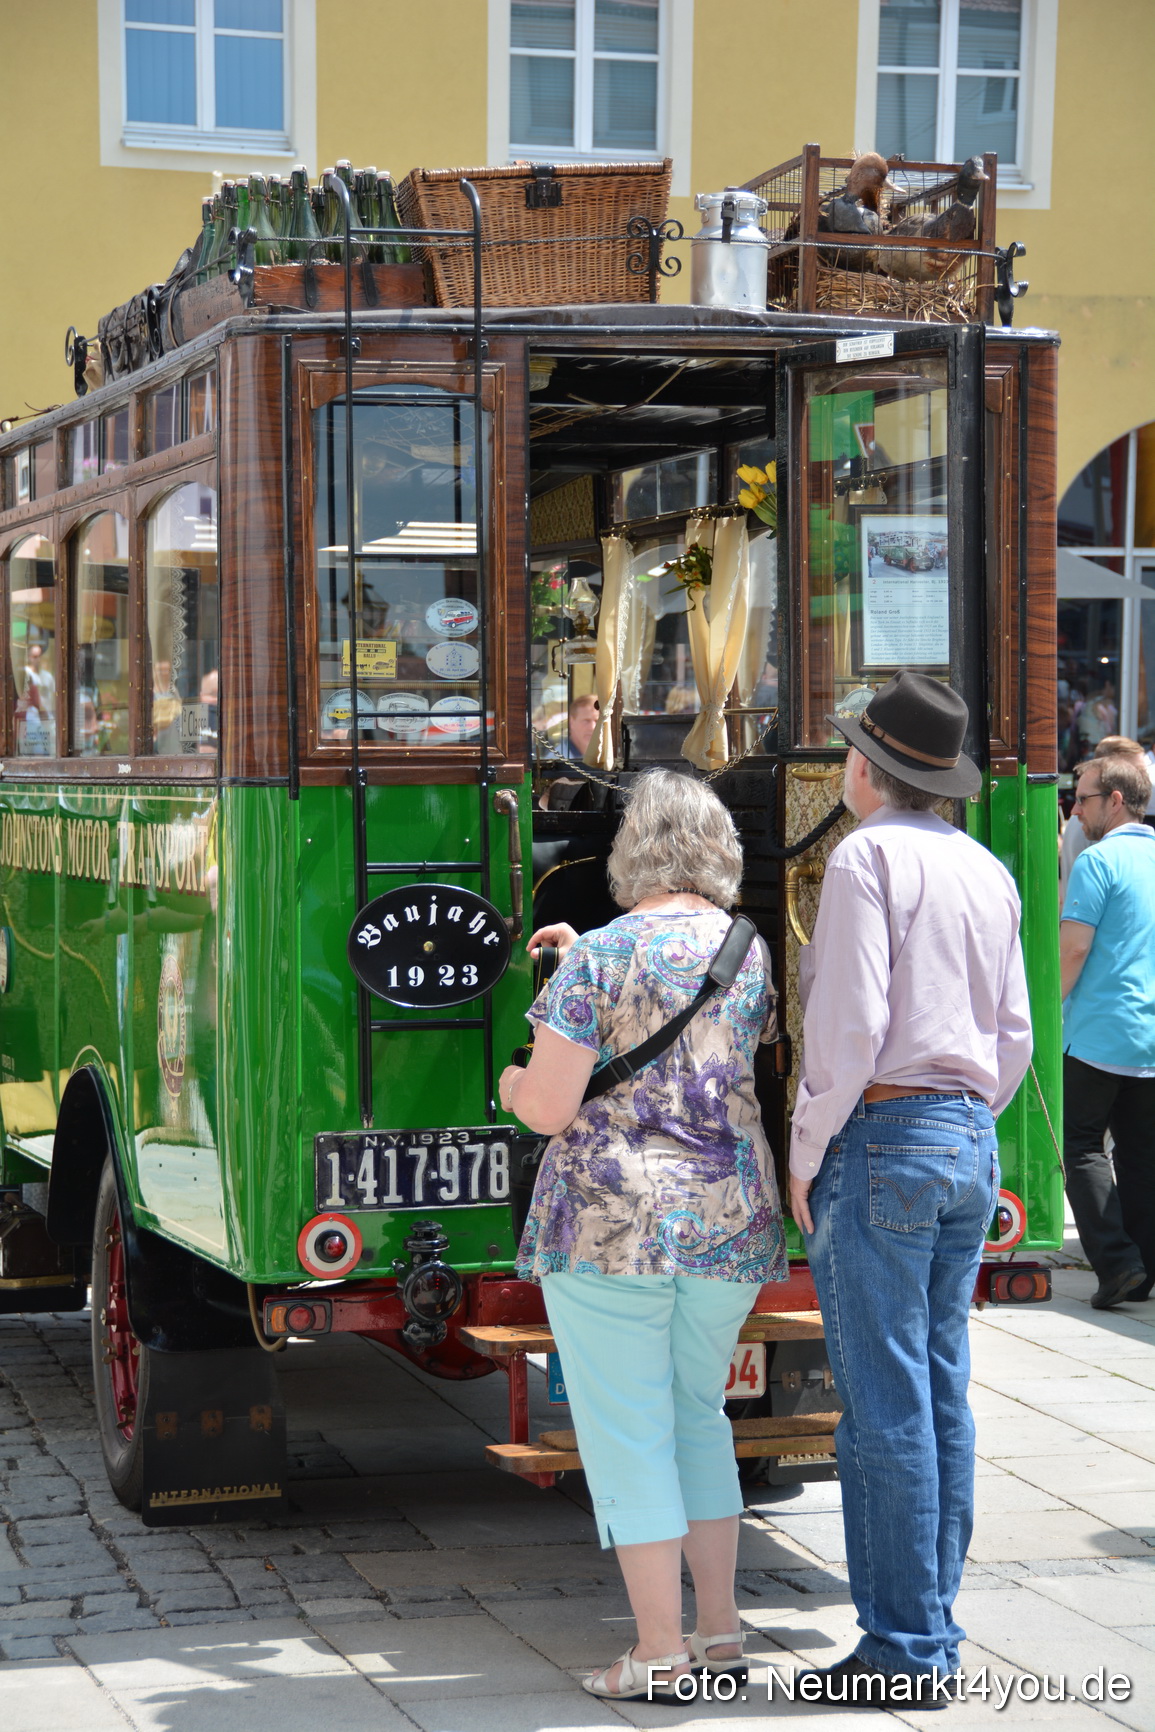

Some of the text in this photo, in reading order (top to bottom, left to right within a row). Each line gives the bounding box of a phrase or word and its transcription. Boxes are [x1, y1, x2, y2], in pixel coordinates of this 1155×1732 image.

[67, 818, 110, 881] MOTOR
[117, 821, 208, 893] TRANSPORT
[357, 895, 500, 950] Baujahr
[412, 1132, 470, 1145] 1923
[152, 1483, 280, 1503] INTERNATIONAL
